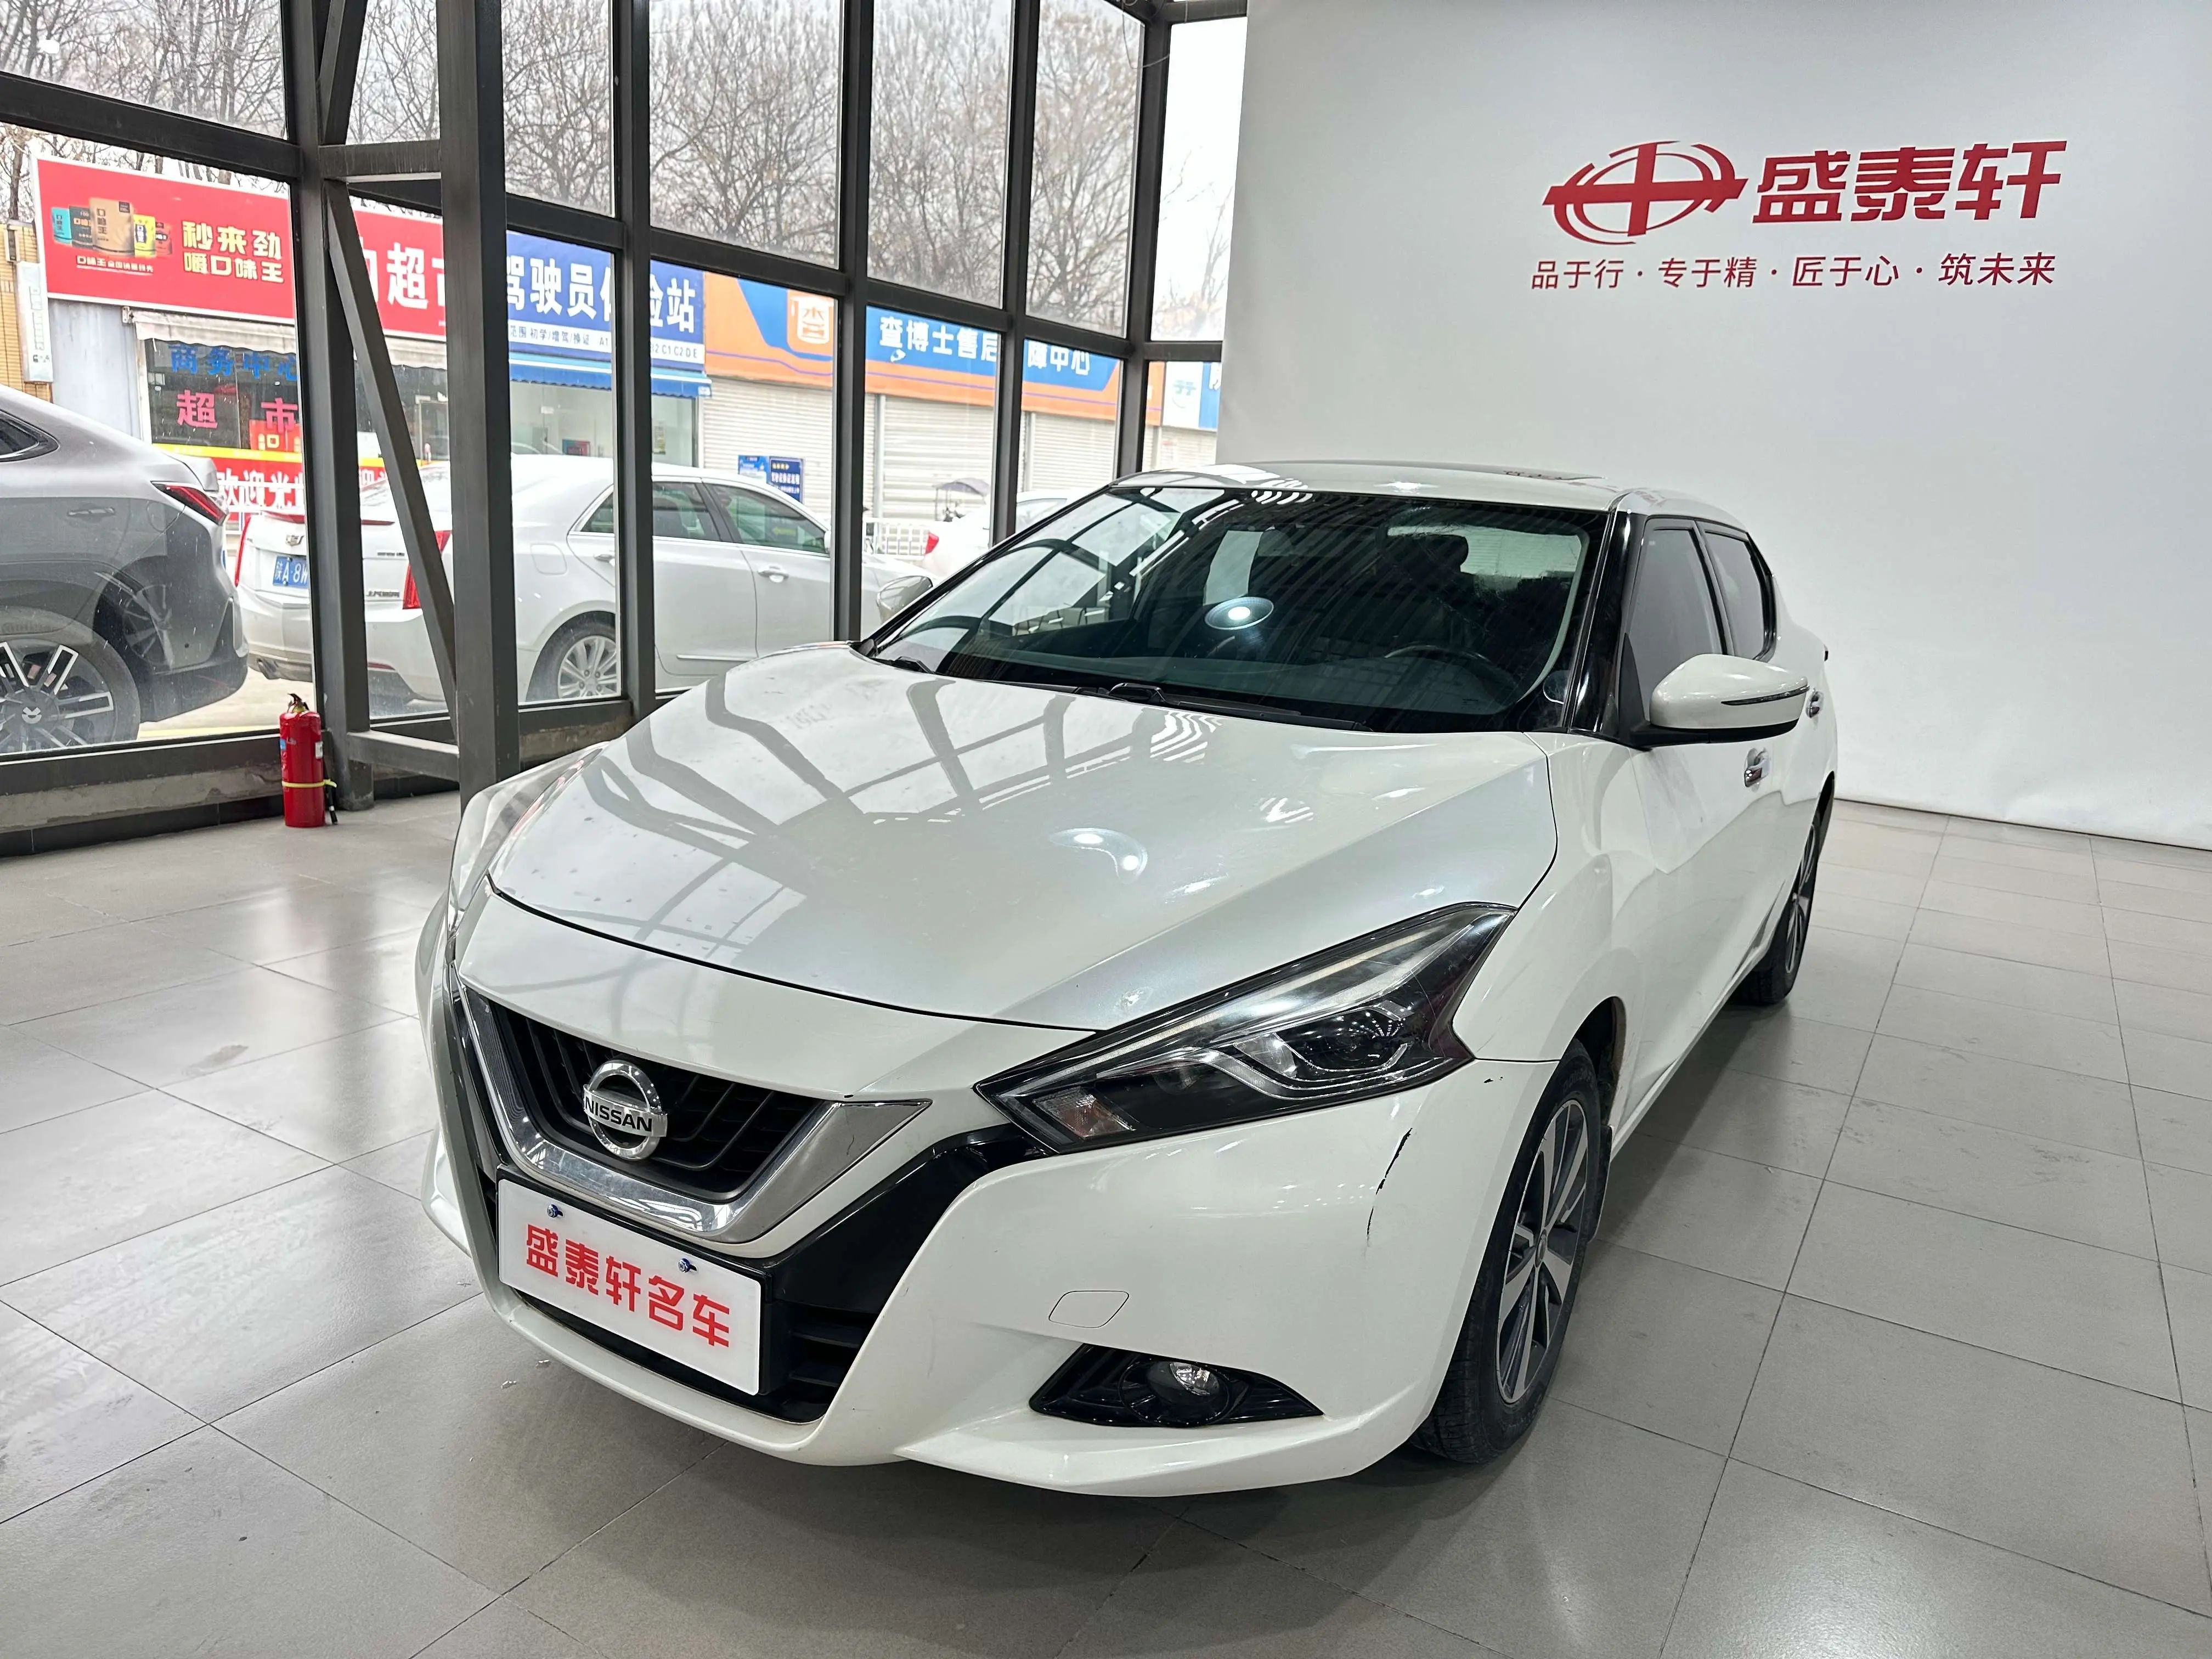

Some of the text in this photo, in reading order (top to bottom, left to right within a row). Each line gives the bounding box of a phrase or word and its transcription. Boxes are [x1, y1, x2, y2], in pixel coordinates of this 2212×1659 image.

[1753, 140, 2067, 224] 盛泰轩
[182, 221, 281, 260] 秒来劲
[183, 251, 284, 283] 嚼口味王
[585, 1096, 652, 1132] NISSAN
[526, 1224, 731, 1348] 盛泰轩名车
